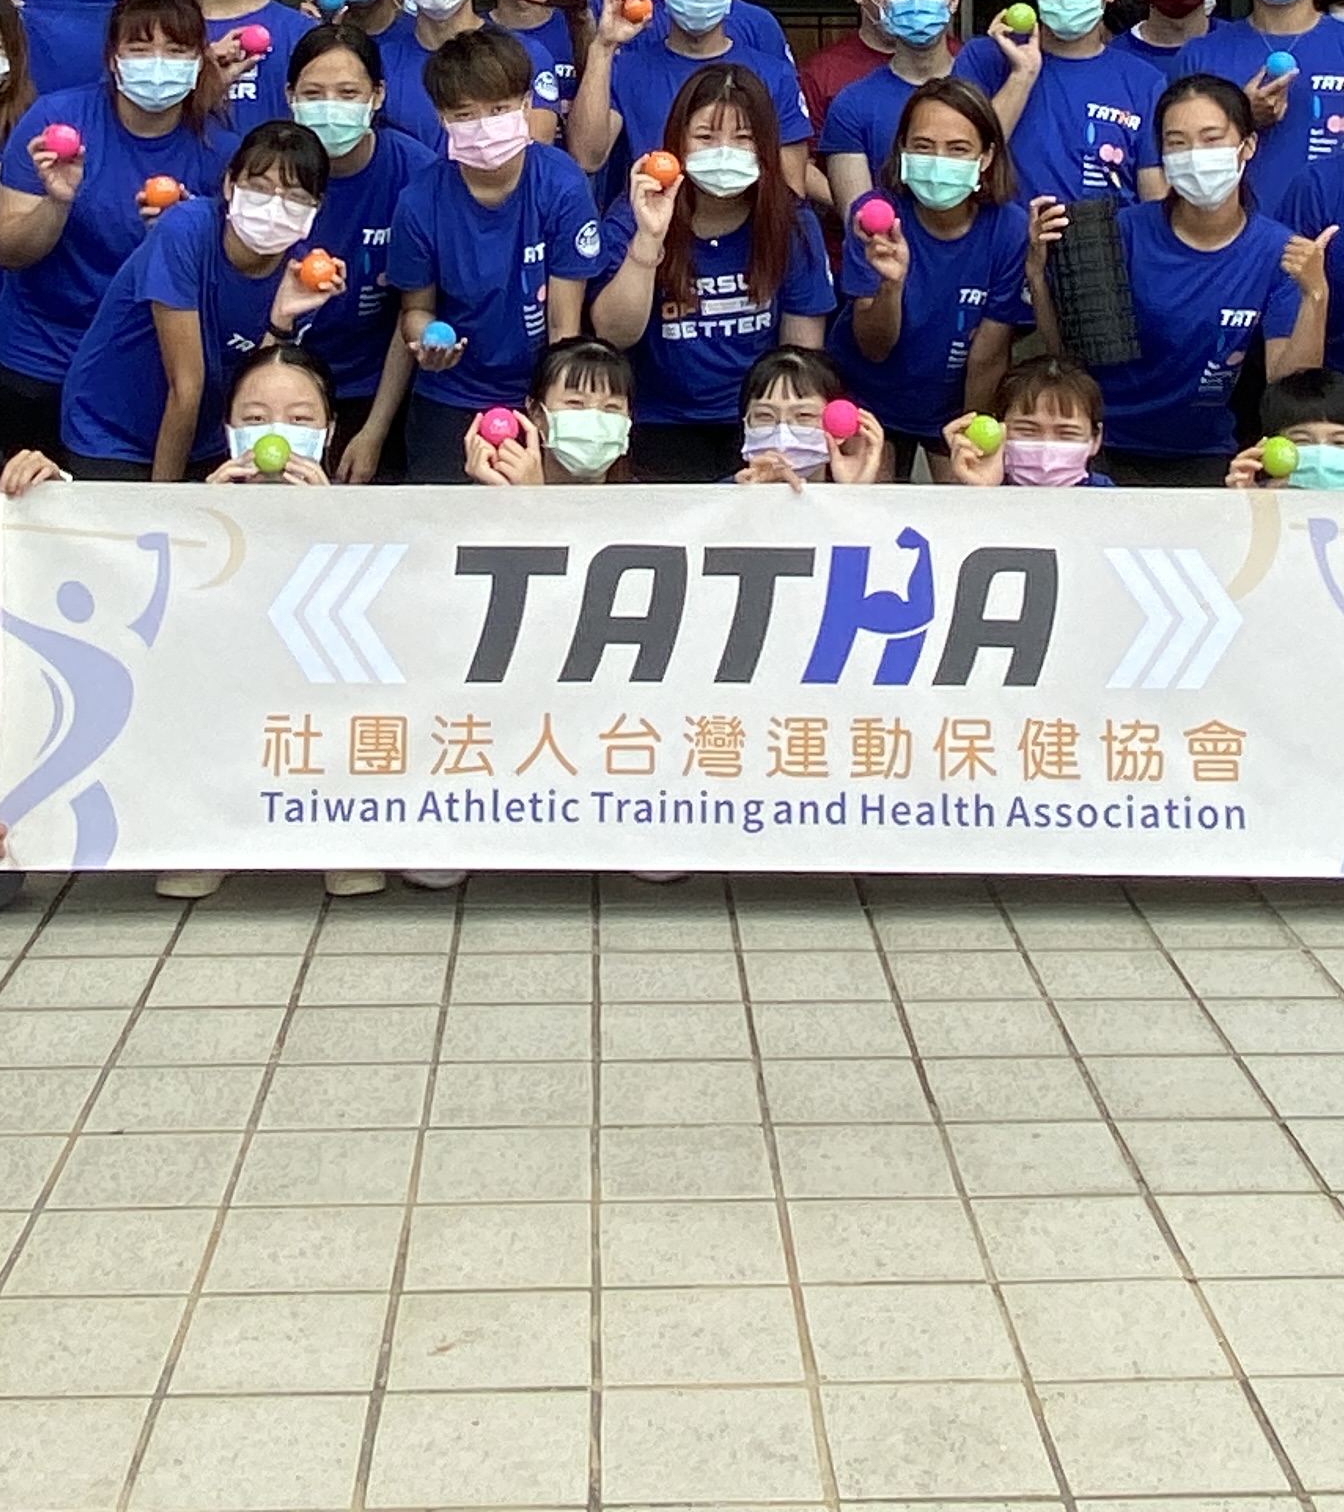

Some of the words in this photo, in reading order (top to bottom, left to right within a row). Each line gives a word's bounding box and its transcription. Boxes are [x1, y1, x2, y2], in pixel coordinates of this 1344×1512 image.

[1220, 308, 1258, 328] TAT
[455, 528, 1058, 687] TATHA
[261, 712, 1247, 783] 社團法人台灣運動保健協會
[260, 790, 406, 824] Taiwan
[417, 789, 581, 824] Athletic
[591, 790, 765, 834] Training
[773, 791, 848, 826] and
[861, 793, 995, 829] Health
[1006, 794, 1247, 831] Association
